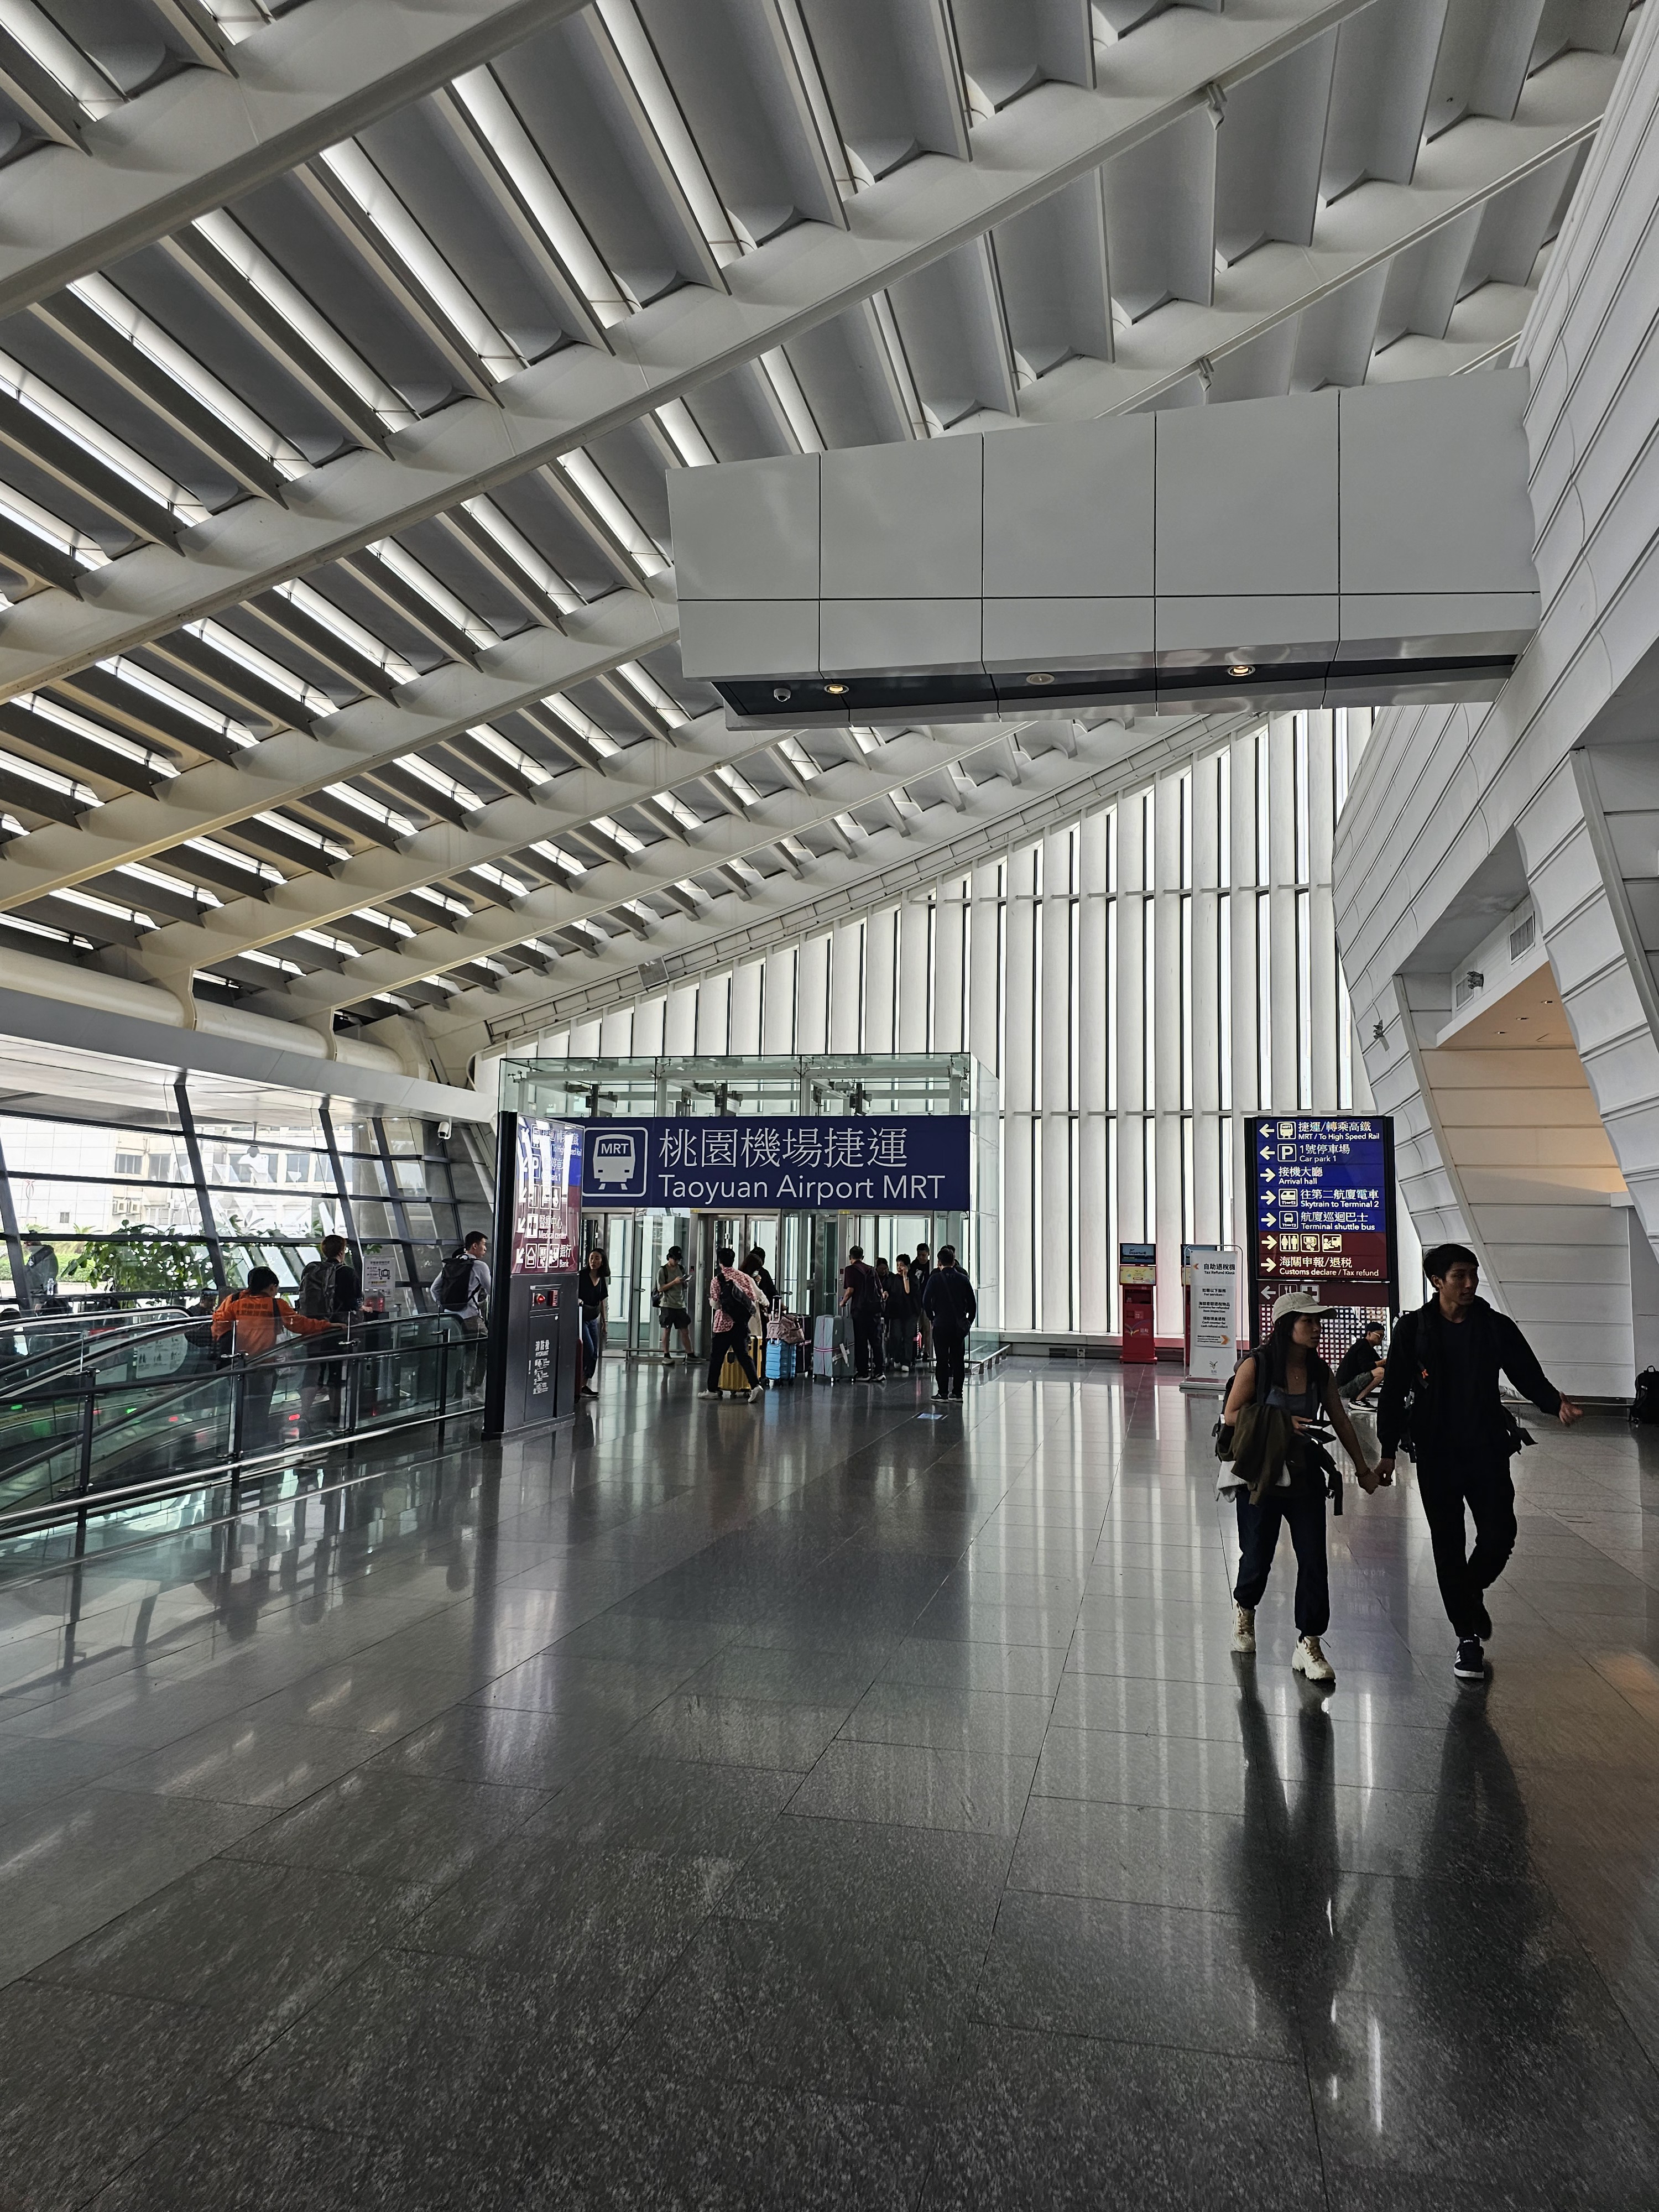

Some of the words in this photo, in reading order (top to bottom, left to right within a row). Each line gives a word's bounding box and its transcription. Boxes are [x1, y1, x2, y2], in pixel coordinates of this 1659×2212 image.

[1298, 1121, 1371, 1132] 捷運/轉乘高鐵
[601, 1143, 629, 1154] MRT
[659, 1128, 907, 1168] 桃園機場捷運
[1282, 1146, 1293, 1160] P
[1300, 1144, 1350, 1154] 1號停車場
[1314, 1155, 1331, 1164] park
[1279, 1166, 1323, 1177] 接機大廳
[658, 1175, 768, 1204] Taoyuan
[776, 1175, 874, 1206] Airport
[884, 1175, 946, 1199] MRT
[1300, 1189, 1379, 1200] 往第二航廈電車
[1301, 1201, 1329, 1209] Skytrain
[1301, 1211, 1368, 1222] 航廈巡迴巴士
[559, 1259, 569, 1267] Bank
